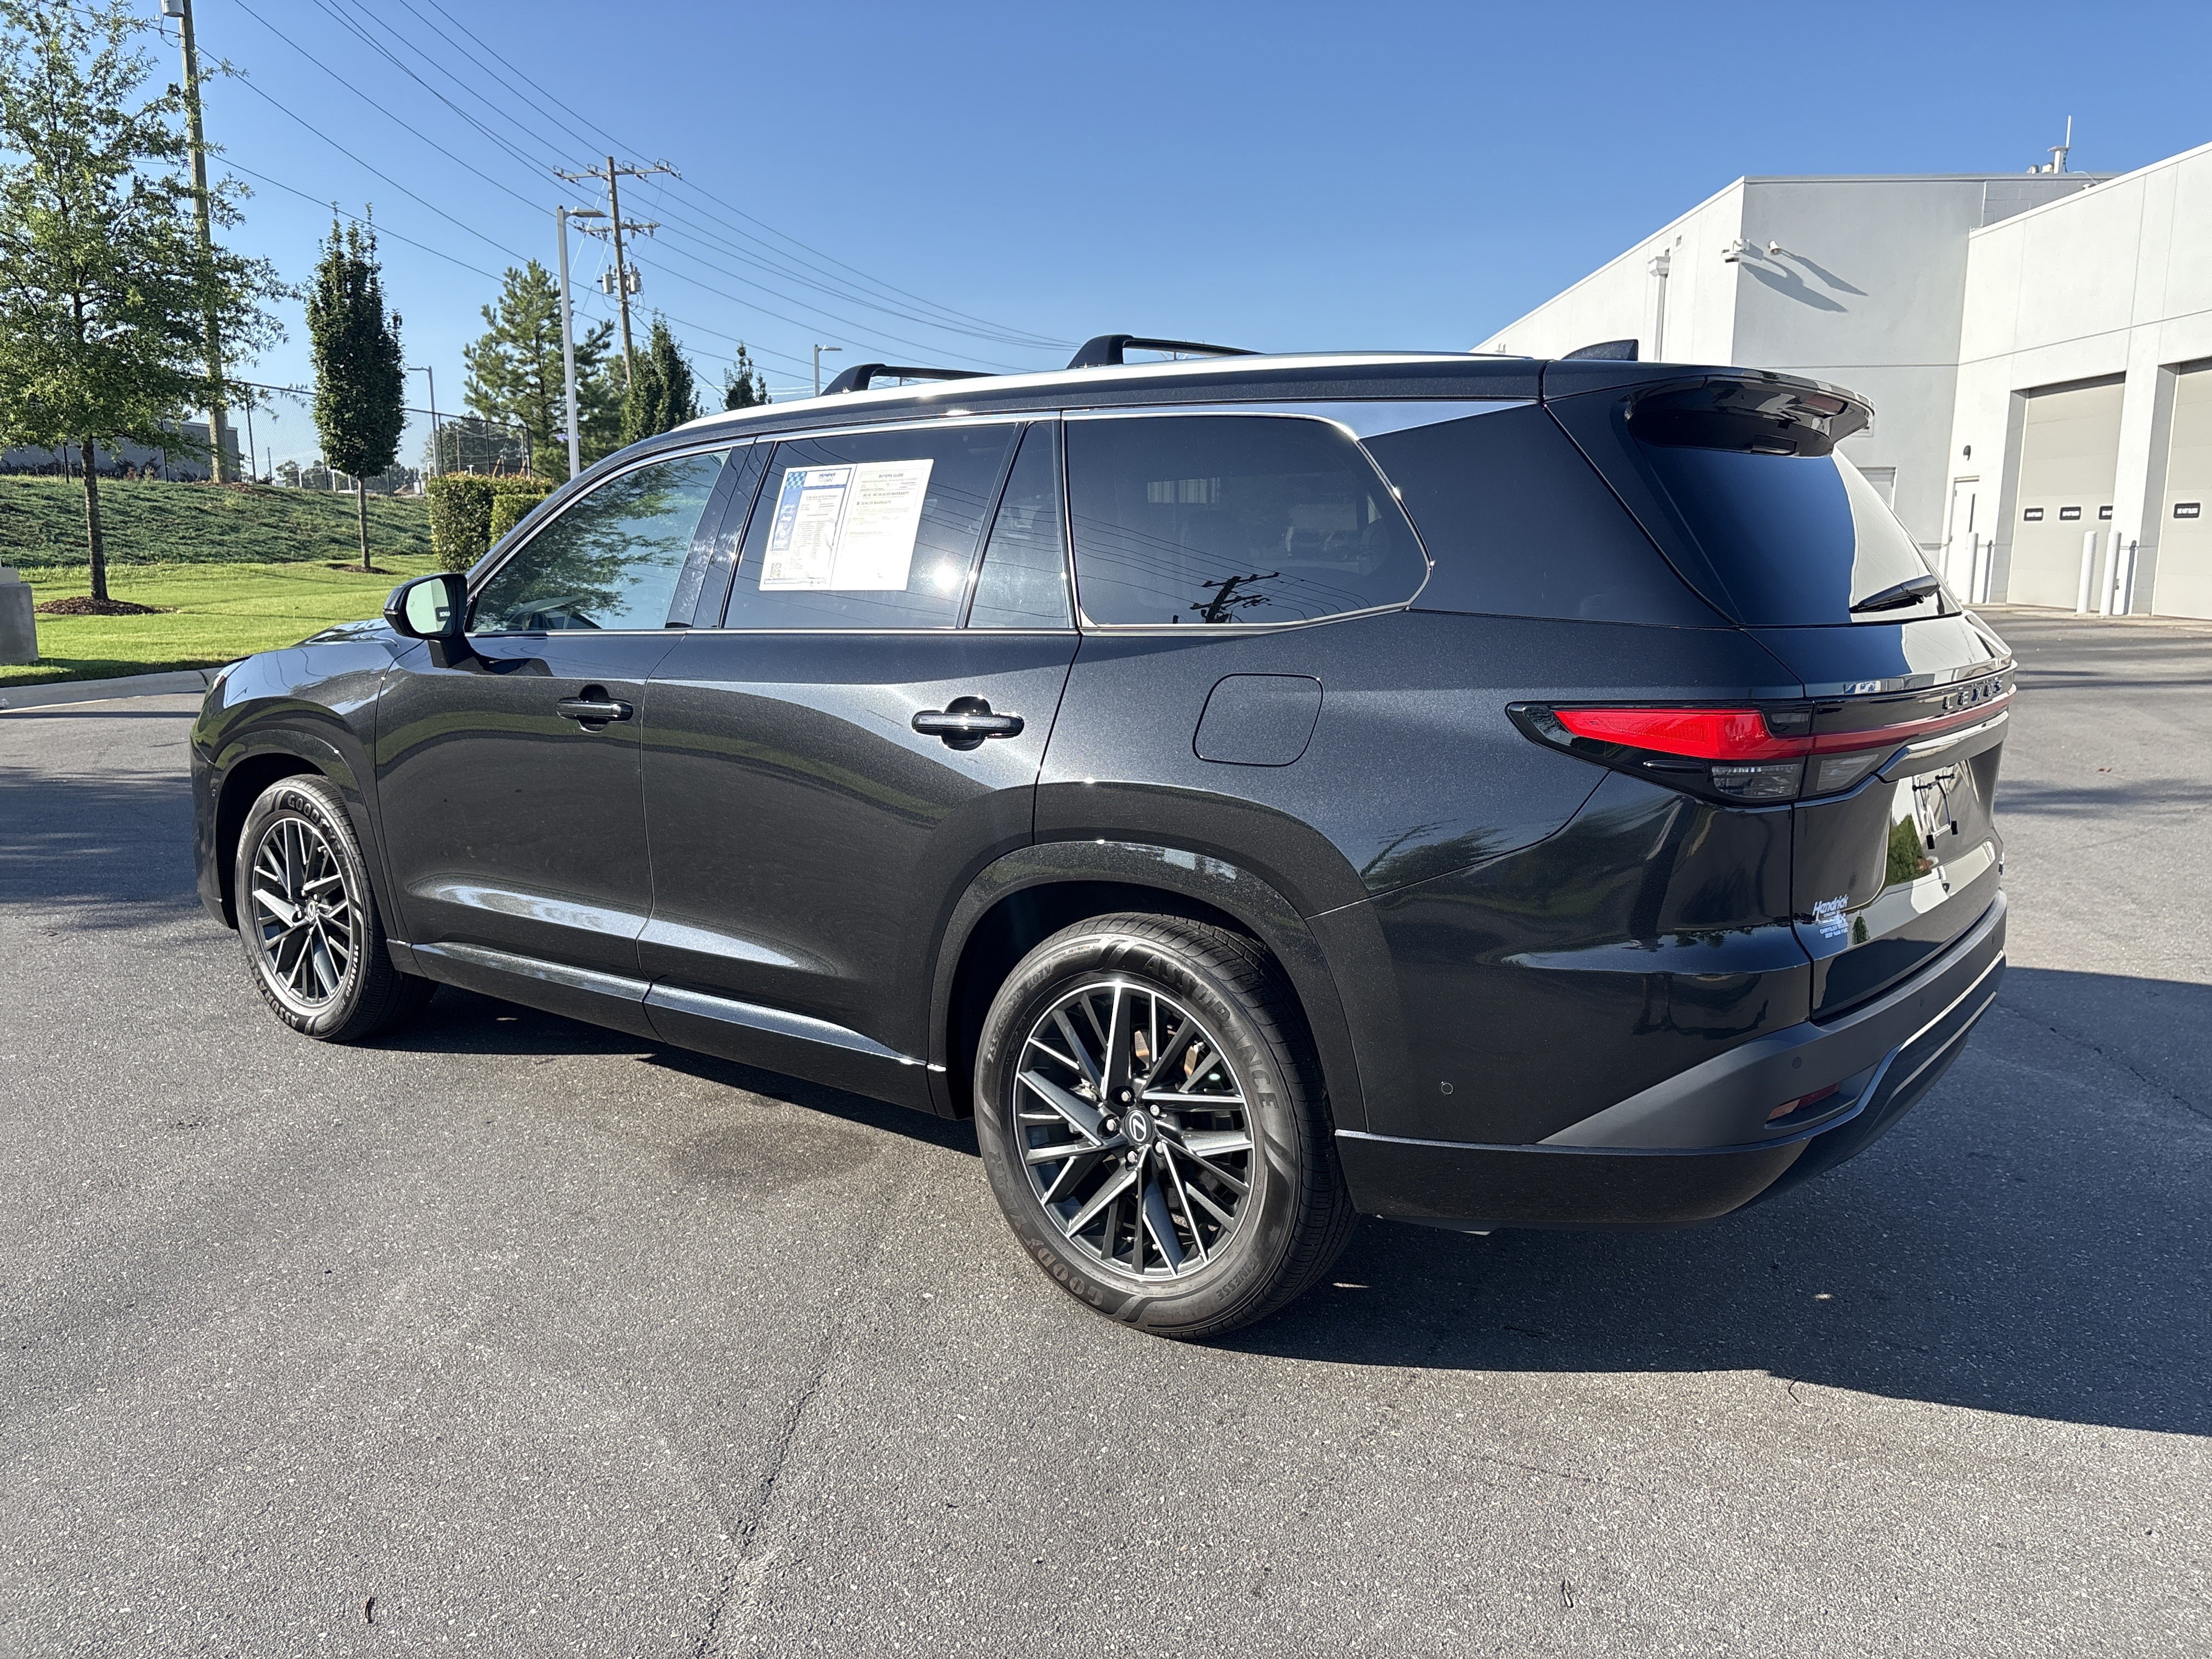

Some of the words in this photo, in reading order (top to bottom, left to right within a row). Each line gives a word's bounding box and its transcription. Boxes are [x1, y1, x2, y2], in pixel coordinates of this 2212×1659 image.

[1942, 680, 2002, 710] LEXUS
[1812, 894, 1849, 920] Hendrick
[1027, 964, 1052, 990] 107V
[1143, 955, 1279, 1109] ASSURANCE
[989, 1151, 1104, 1306] GOODYEAR
[1216, 1252, 1260, 1301] FINESSE
